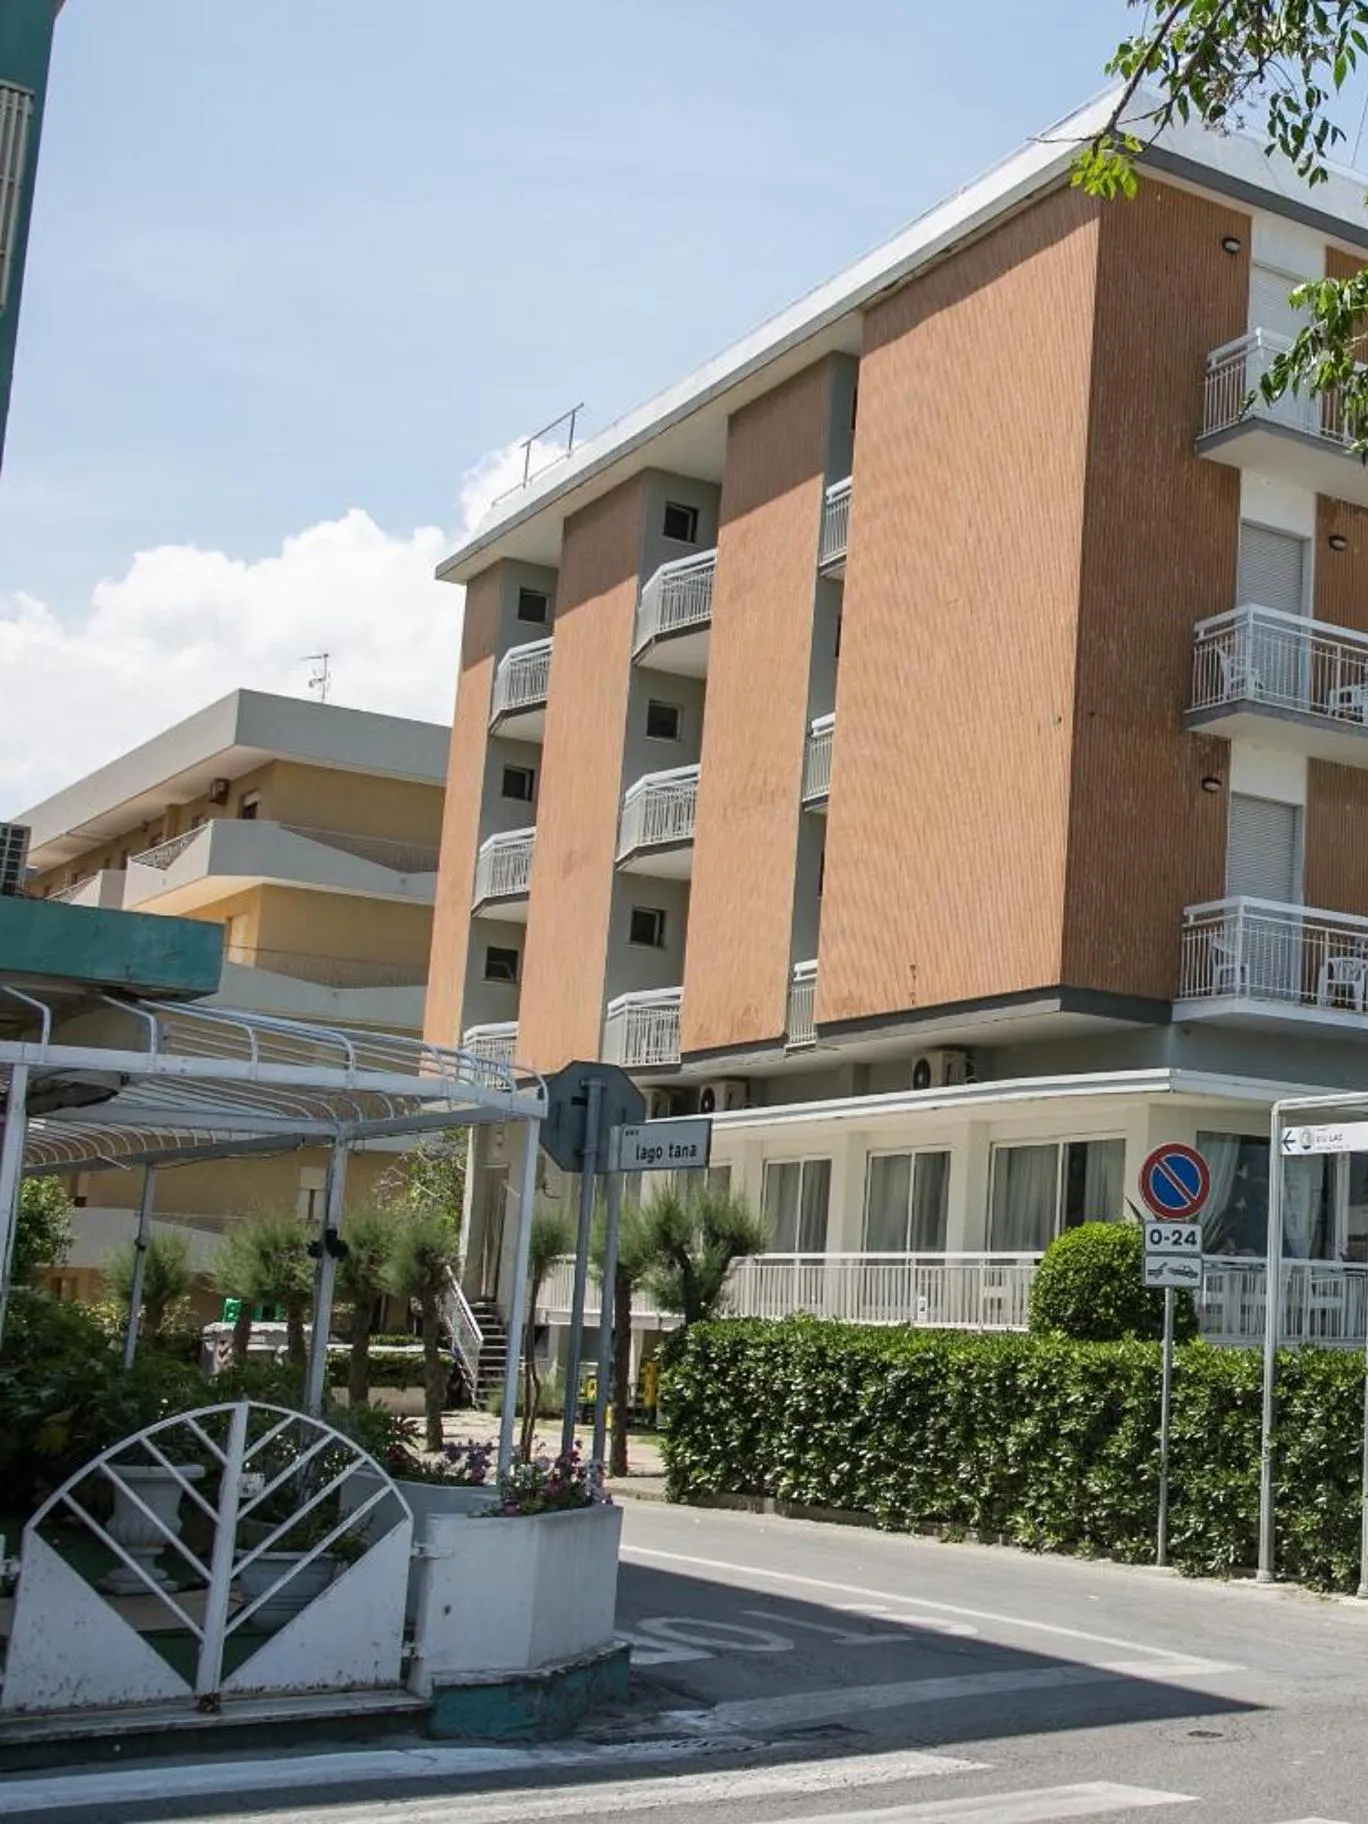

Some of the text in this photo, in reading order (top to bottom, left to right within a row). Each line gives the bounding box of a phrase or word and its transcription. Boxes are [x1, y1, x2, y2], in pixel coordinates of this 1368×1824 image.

[635, 1142, 697, 1164] lago tana
[1149, 1228, 1198, 1247] 0-24
